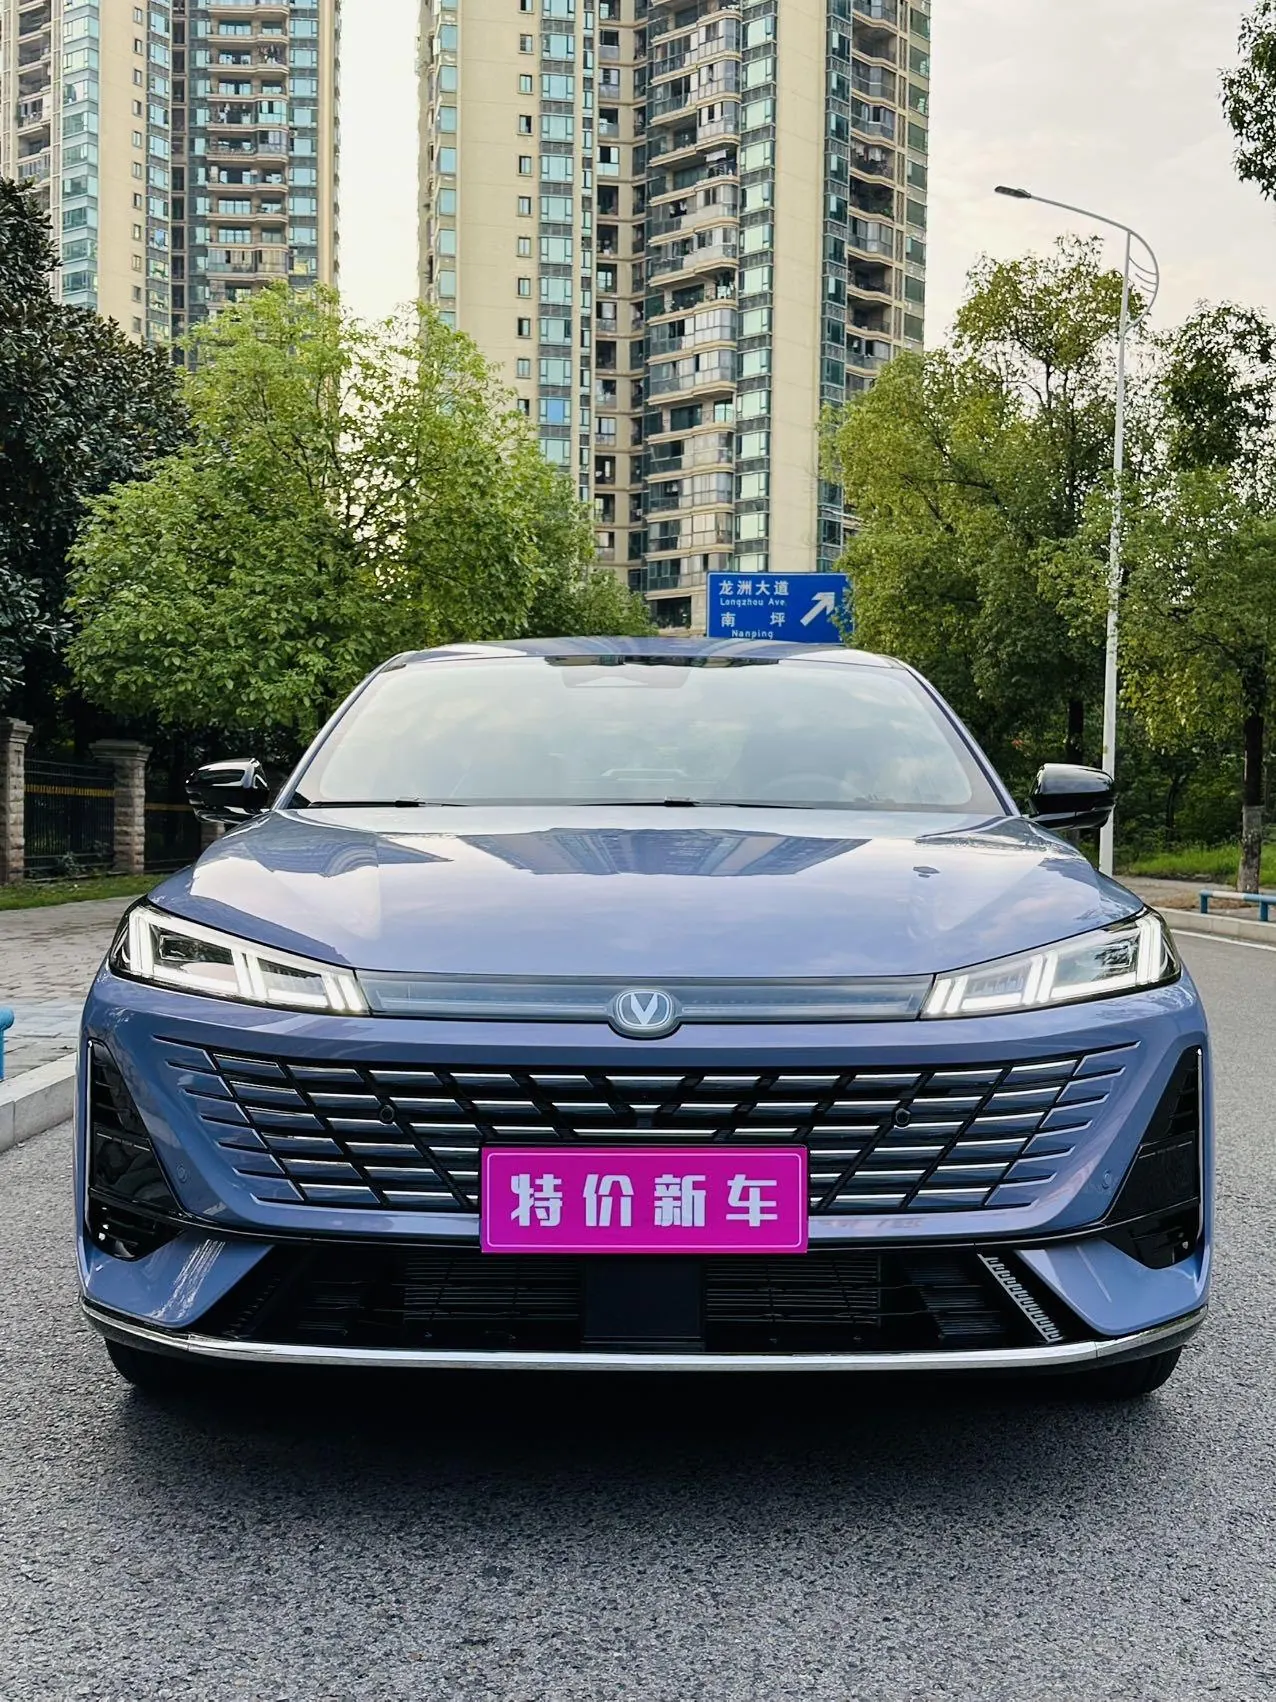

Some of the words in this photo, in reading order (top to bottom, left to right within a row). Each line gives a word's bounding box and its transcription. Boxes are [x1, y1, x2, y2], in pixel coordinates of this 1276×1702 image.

[719, 580, 789, 596] 龙洲大道
[720, 598, 764, 608] Longzhou
[731, 629, 774, 639] Nanping
[510, 1173, 779, 1227] 特价新车
